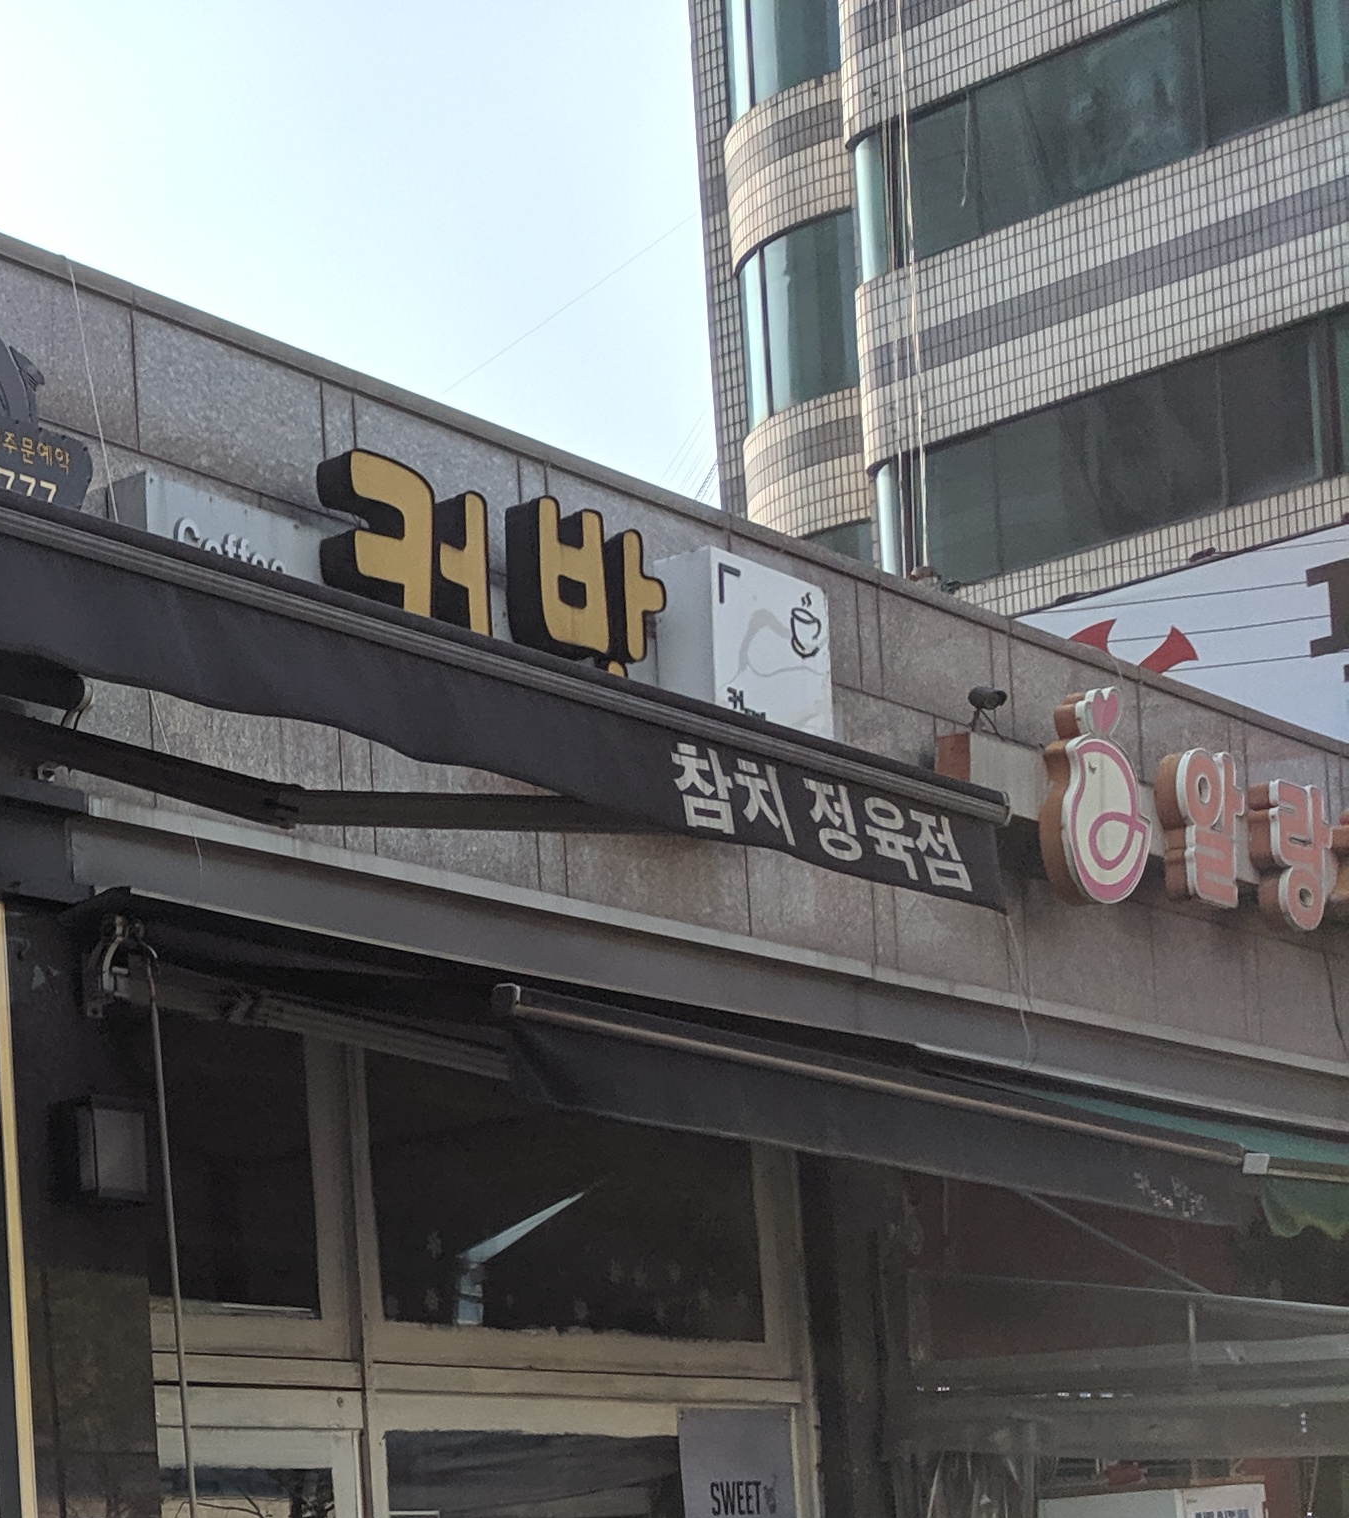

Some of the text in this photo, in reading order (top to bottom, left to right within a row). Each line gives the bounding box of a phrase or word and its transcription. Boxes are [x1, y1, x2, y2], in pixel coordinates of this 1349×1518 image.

[671, 742, 974, 892] 참치 정육점
[710, 1480, 761, 1516] SWEET
